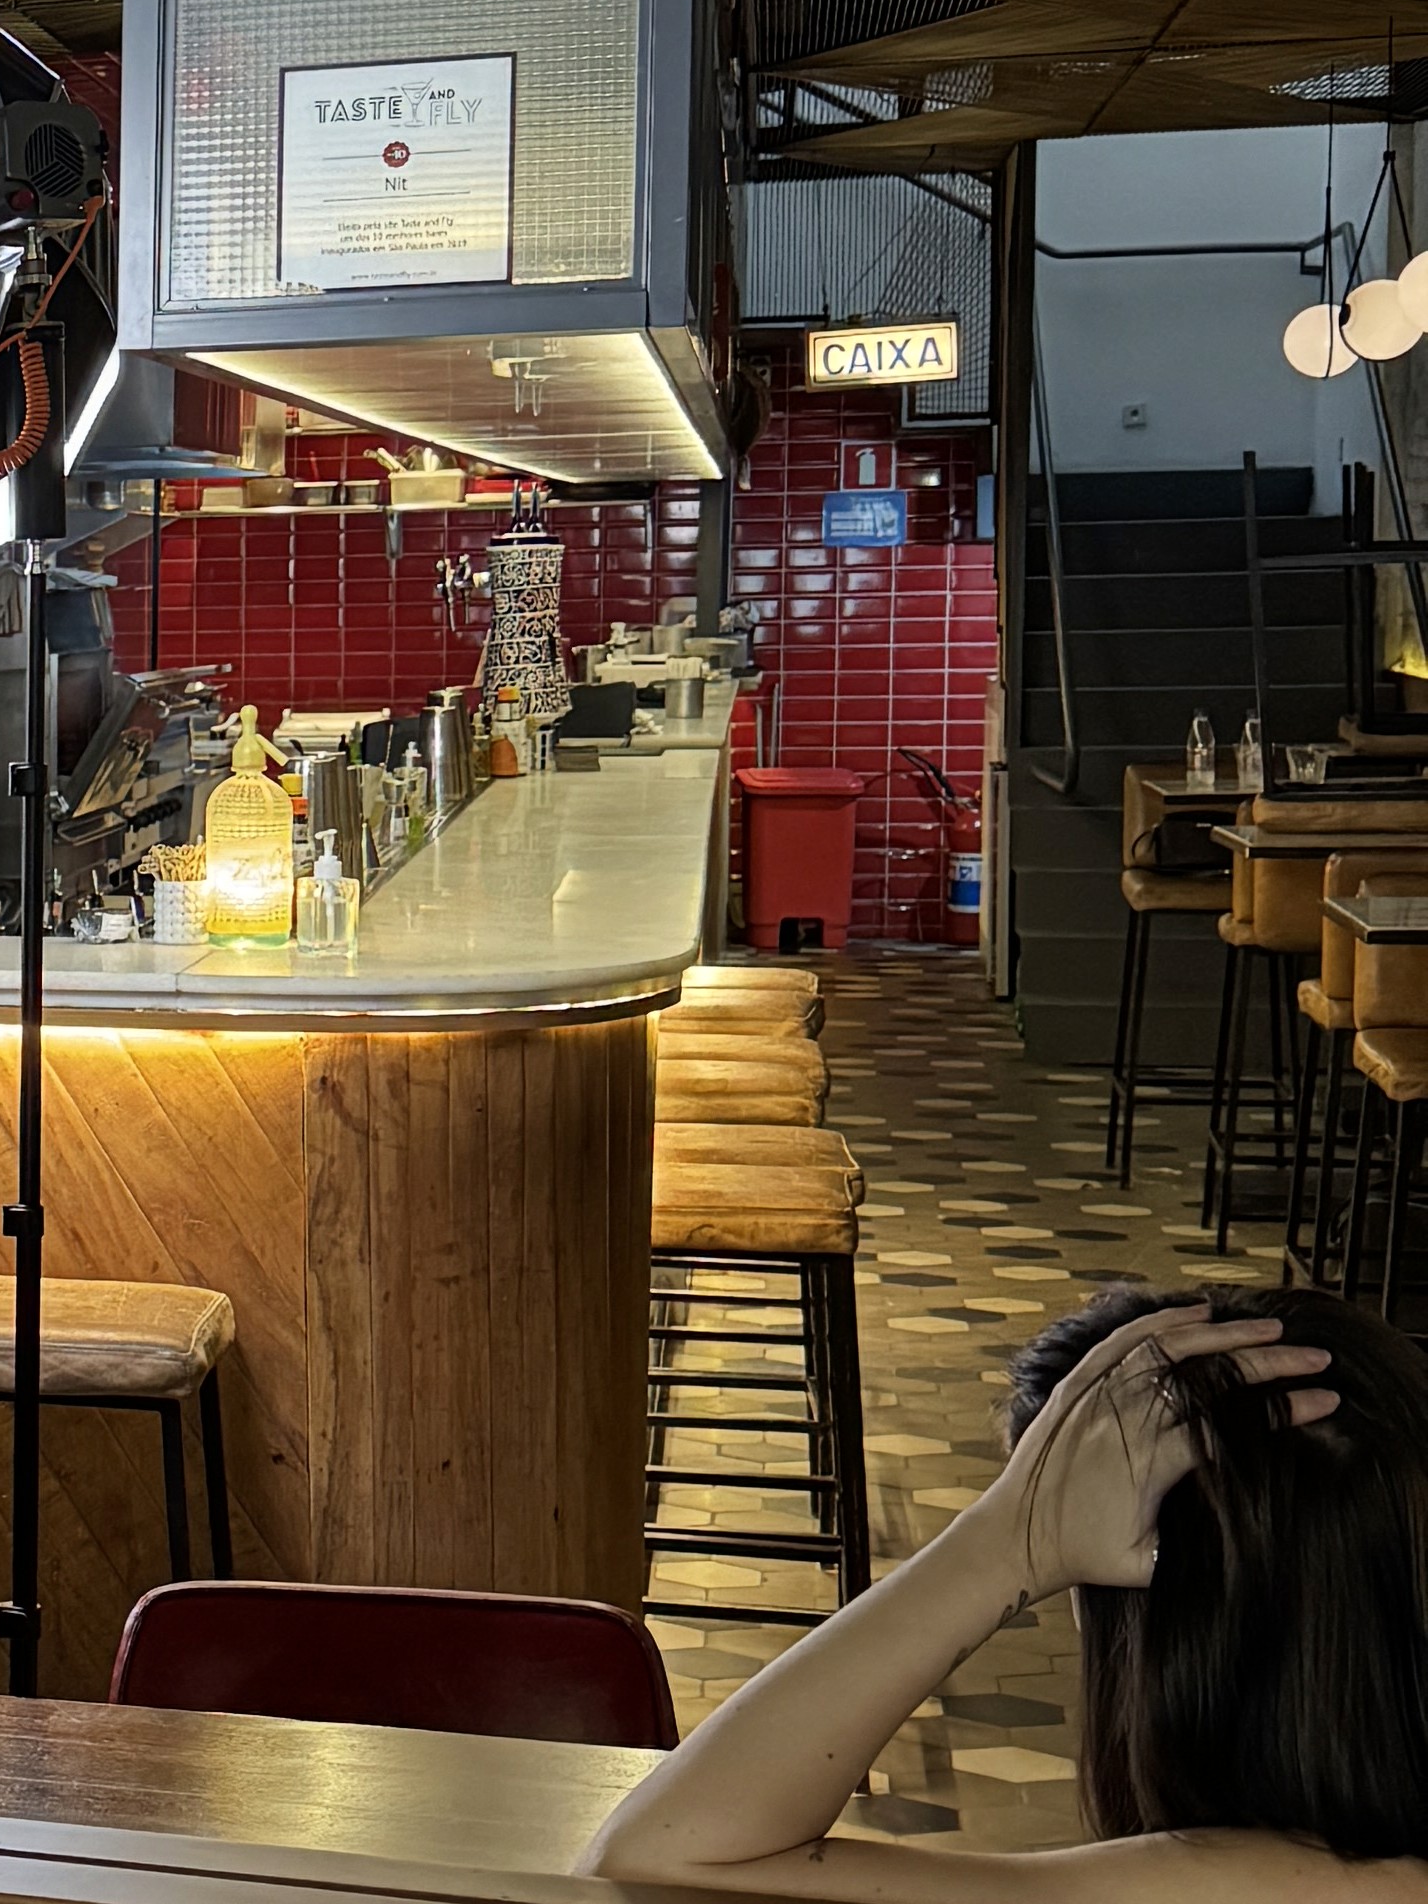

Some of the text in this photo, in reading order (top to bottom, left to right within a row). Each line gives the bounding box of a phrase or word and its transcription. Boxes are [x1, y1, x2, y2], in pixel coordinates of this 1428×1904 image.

[428, 89, 456, 100] AND
[314, 95, 483, 127] TASTE FLY
[385, 176, 408, 191] Nit
[822, 337, 944, 375] CAIXA
